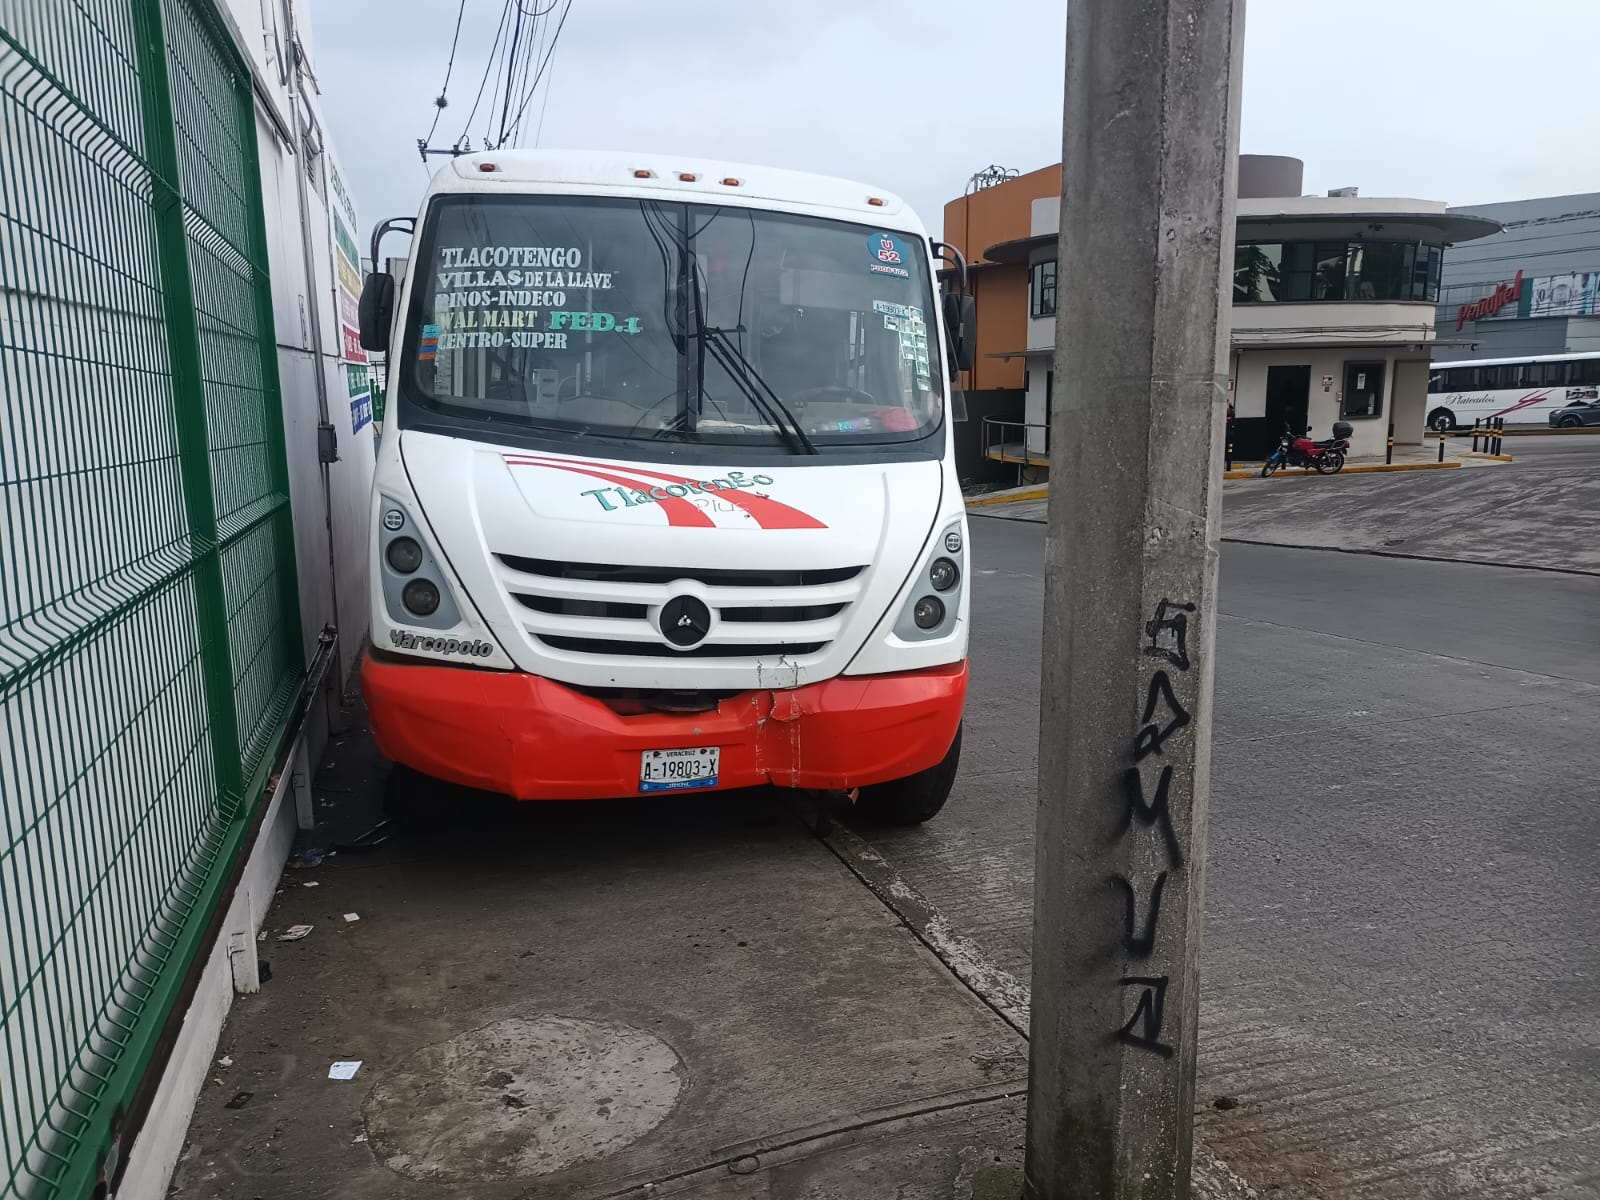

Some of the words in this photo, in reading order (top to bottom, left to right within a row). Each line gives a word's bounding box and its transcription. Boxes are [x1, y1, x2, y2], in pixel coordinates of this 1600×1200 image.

[881, 239, 893, 251] U
[442, 247, 581, 268] TLACOTENGO
[878, 249, 901, 263] 52
[437, 270, 522, 288] VILLAS
[524, 272, 543, 287] DE
[546, 272, 564, 287] LA
[567, 272, 612, 288] LLAVE
[439, 310, 477, 329] WAL
[483, 310, 538, 328] MART
[438, 332, 567, 348] CENTRO-SUPER
[581, 471, 774, 511] Tlacotengo
[390, 629, 493, 657] Marcopolo
[666, 750, 696, 758] VERACRUZ
[644, 758, 716, 780] A-19803-X
